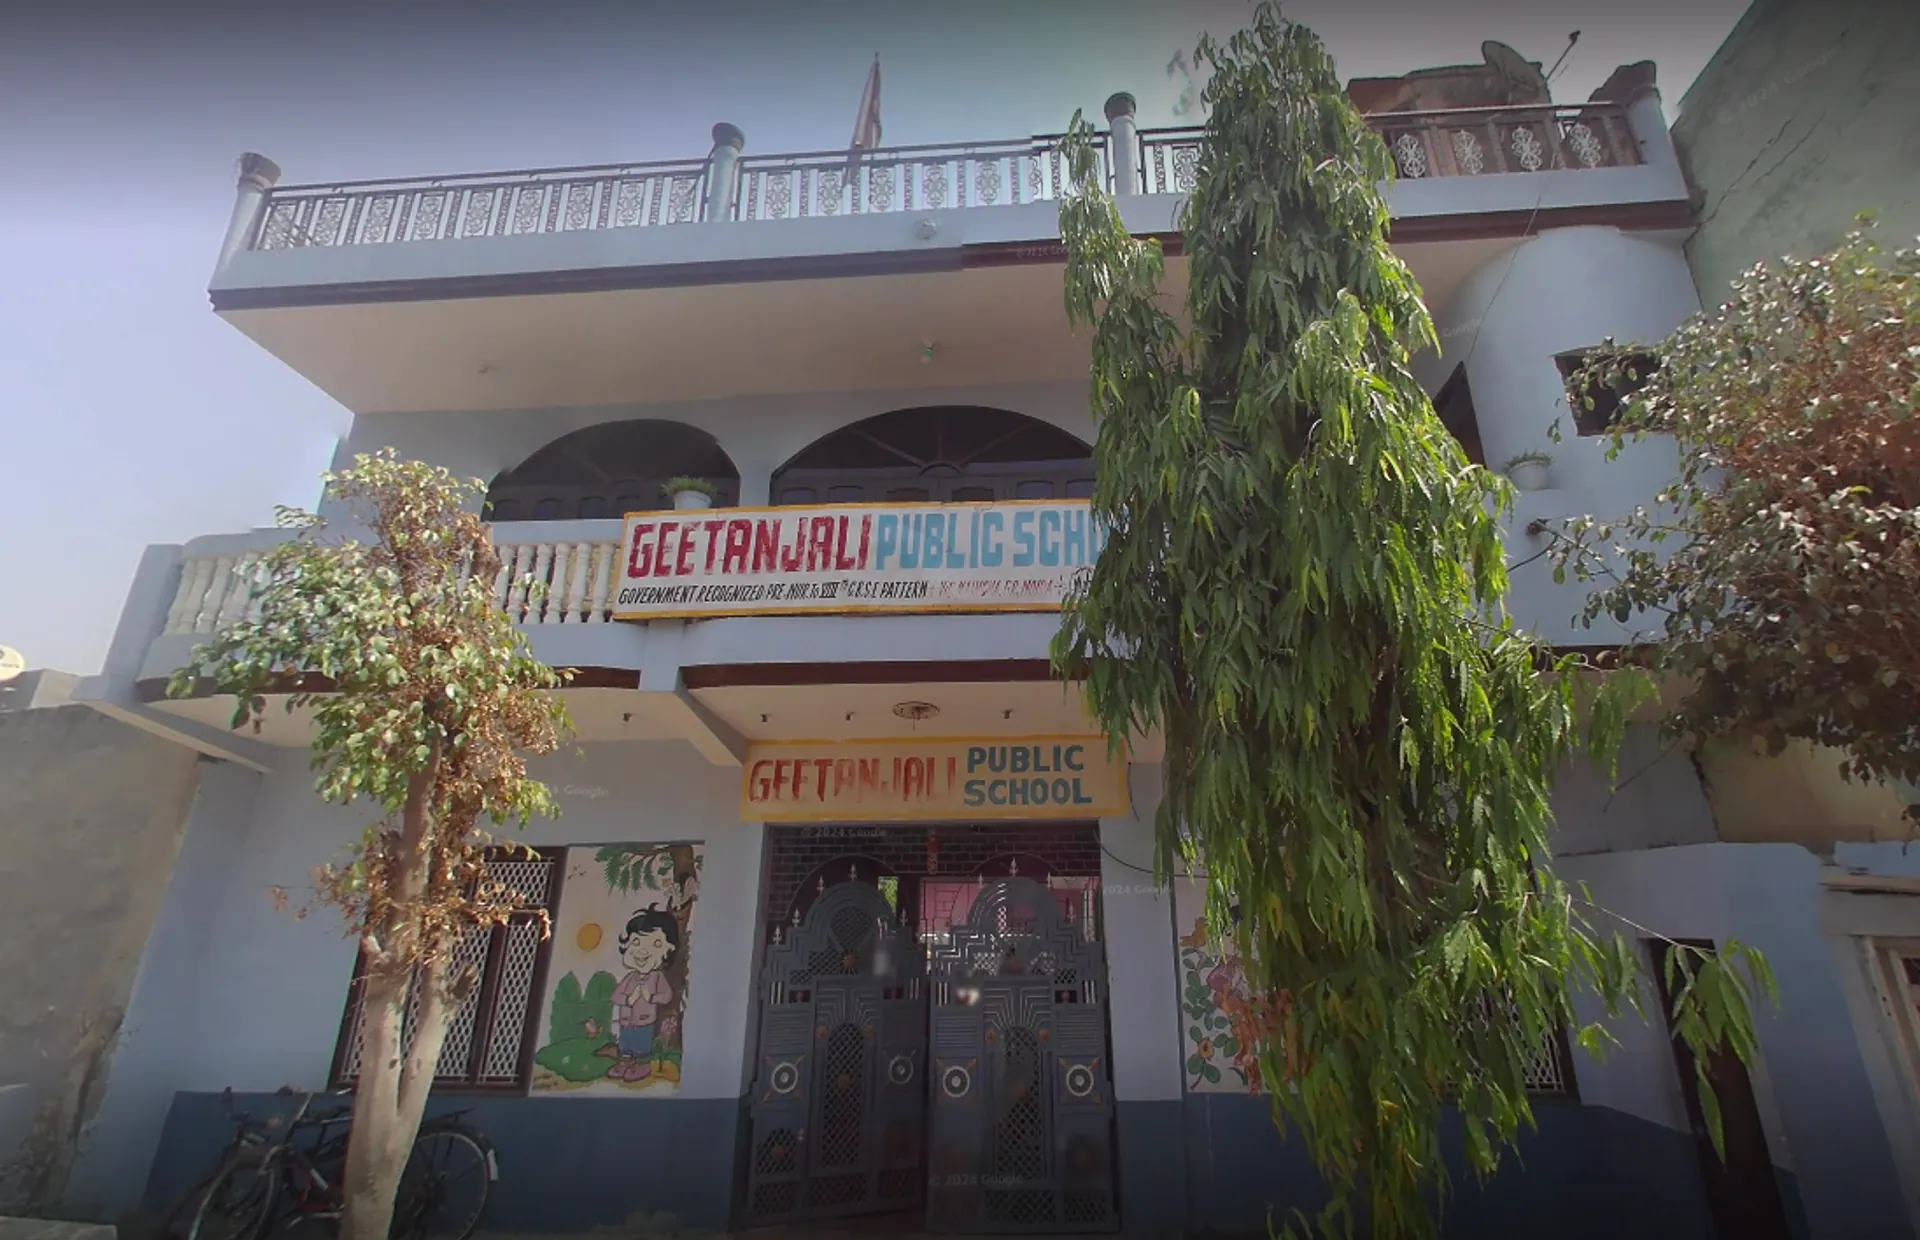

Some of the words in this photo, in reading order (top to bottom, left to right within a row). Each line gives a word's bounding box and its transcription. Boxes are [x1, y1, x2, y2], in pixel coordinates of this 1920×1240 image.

[627, 514, 872, 578] GEETANJALI
[876, 512, 1003, 570] PUBLIC
[1013, 510, 1110, 567] SCHO
[618, 585, 698, 605] GOVERNMENT
[880, 580, 928, 599] PATTERN
[750, 757, 956, 802] GEETANJALI
[967, 745, 1084, 773] PUBLIC
[964, 778, 1093, 806] SCHOOL
